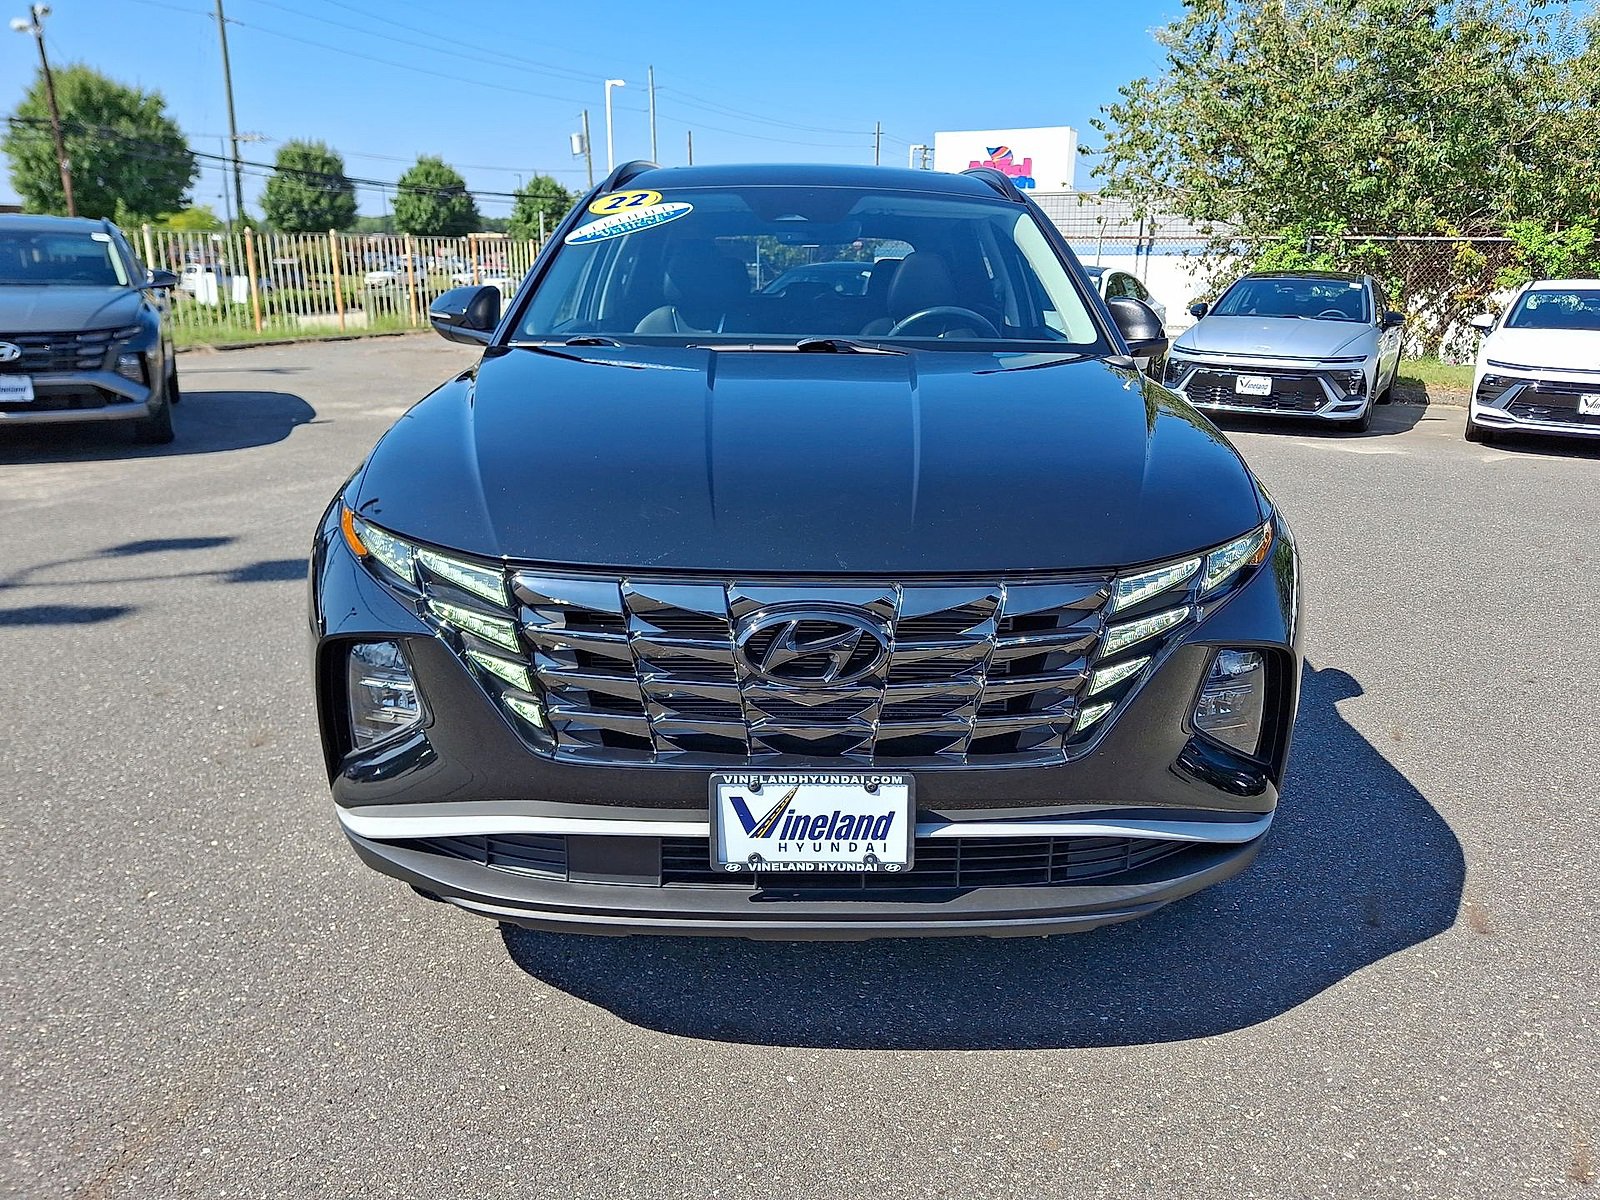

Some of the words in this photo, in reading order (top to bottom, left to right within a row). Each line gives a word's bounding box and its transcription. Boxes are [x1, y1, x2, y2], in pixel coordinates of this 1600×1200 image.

[603, 193, 650, 210] 22
[723, 775, 903, 784] VINELANDHYUNDAI.COM
[729, 784, 896, 841] Vineland
[778, 842, 887, 853] HYUNDAI
[748, 862, 815, 872] VINELAND
[819, 862, 878, 872] HYUNDAI
